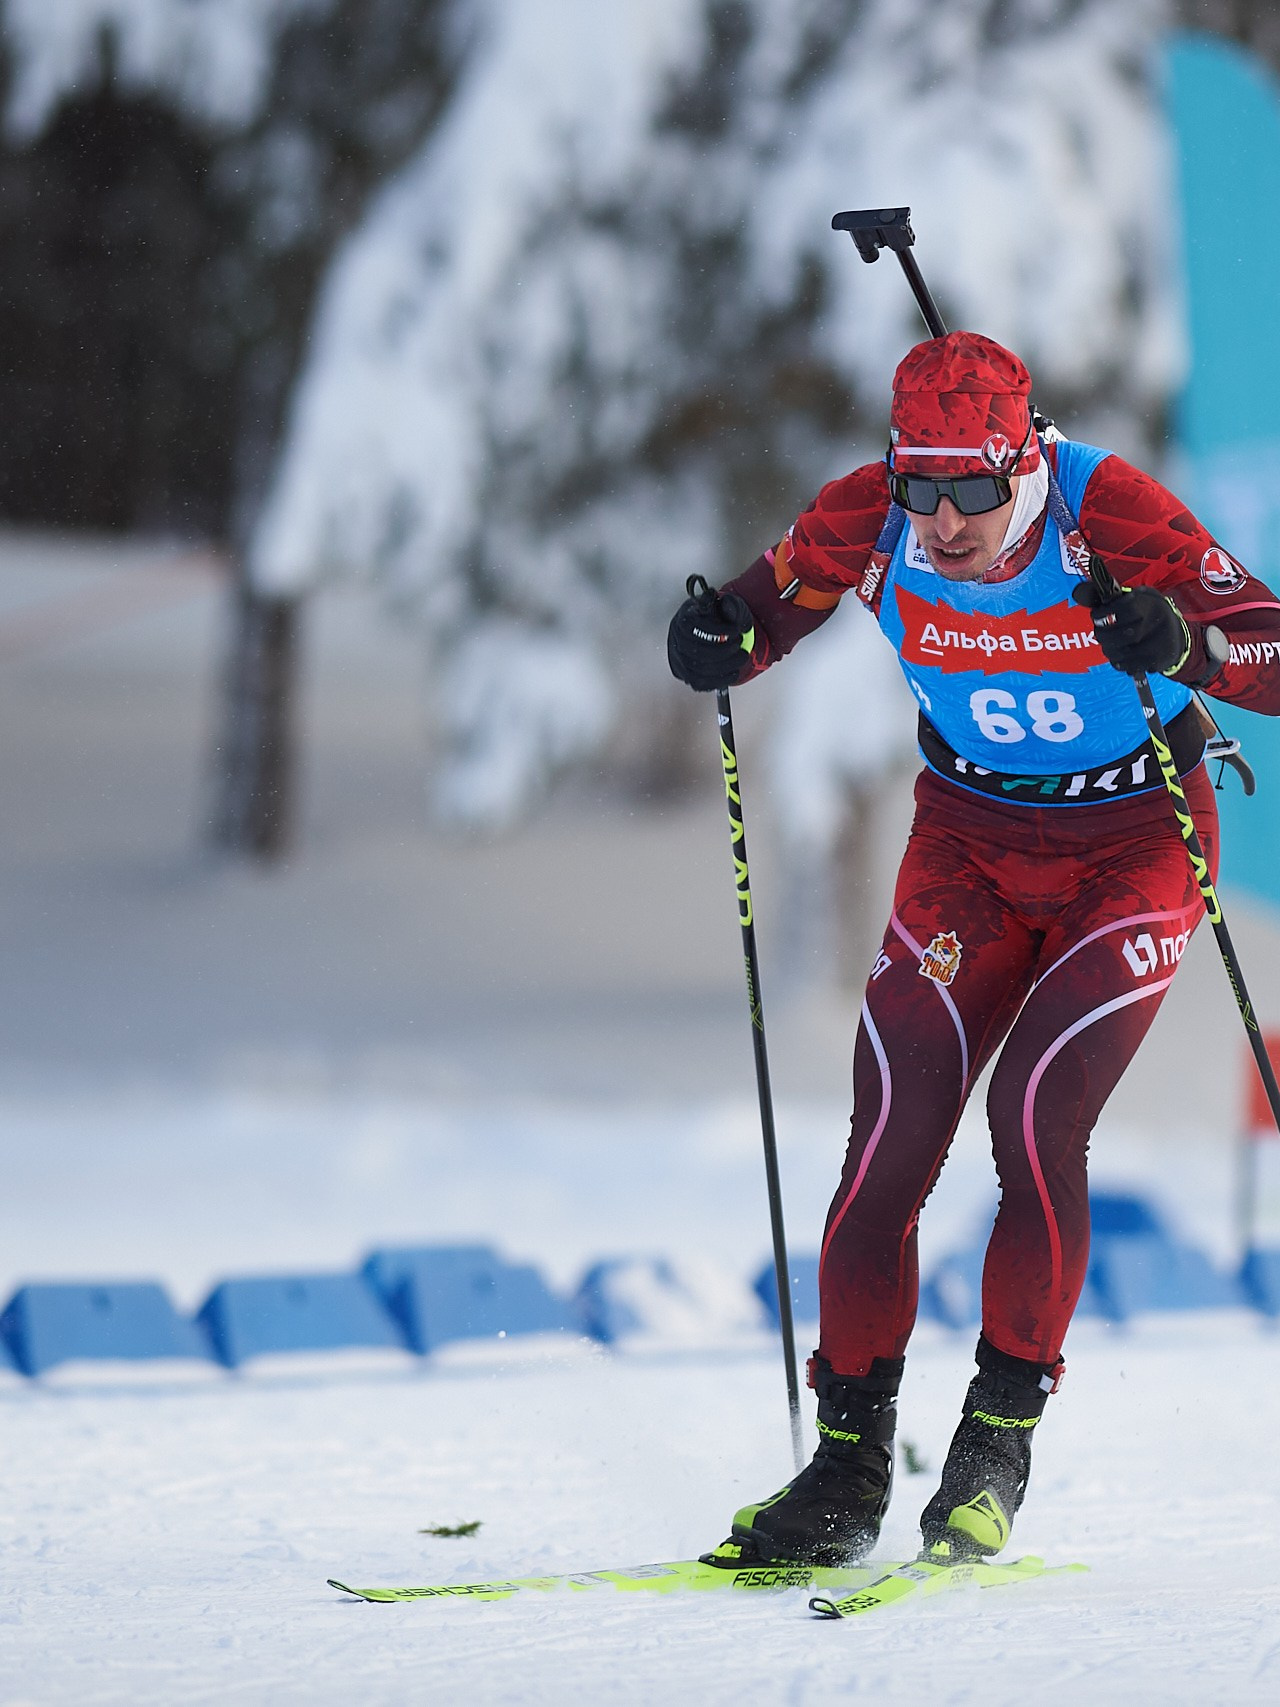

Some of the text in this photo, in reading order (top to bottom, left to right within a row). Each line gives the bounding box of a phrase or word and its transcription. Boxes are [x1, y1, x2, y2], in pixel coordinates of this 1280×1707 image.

[919, 622, 1101, 657] Альфа Банк
[969, 688, 1085, 744] 68
[816, 1417, 861, 1443] CHER
[732, 1570, 814, 1587] FISCHER
